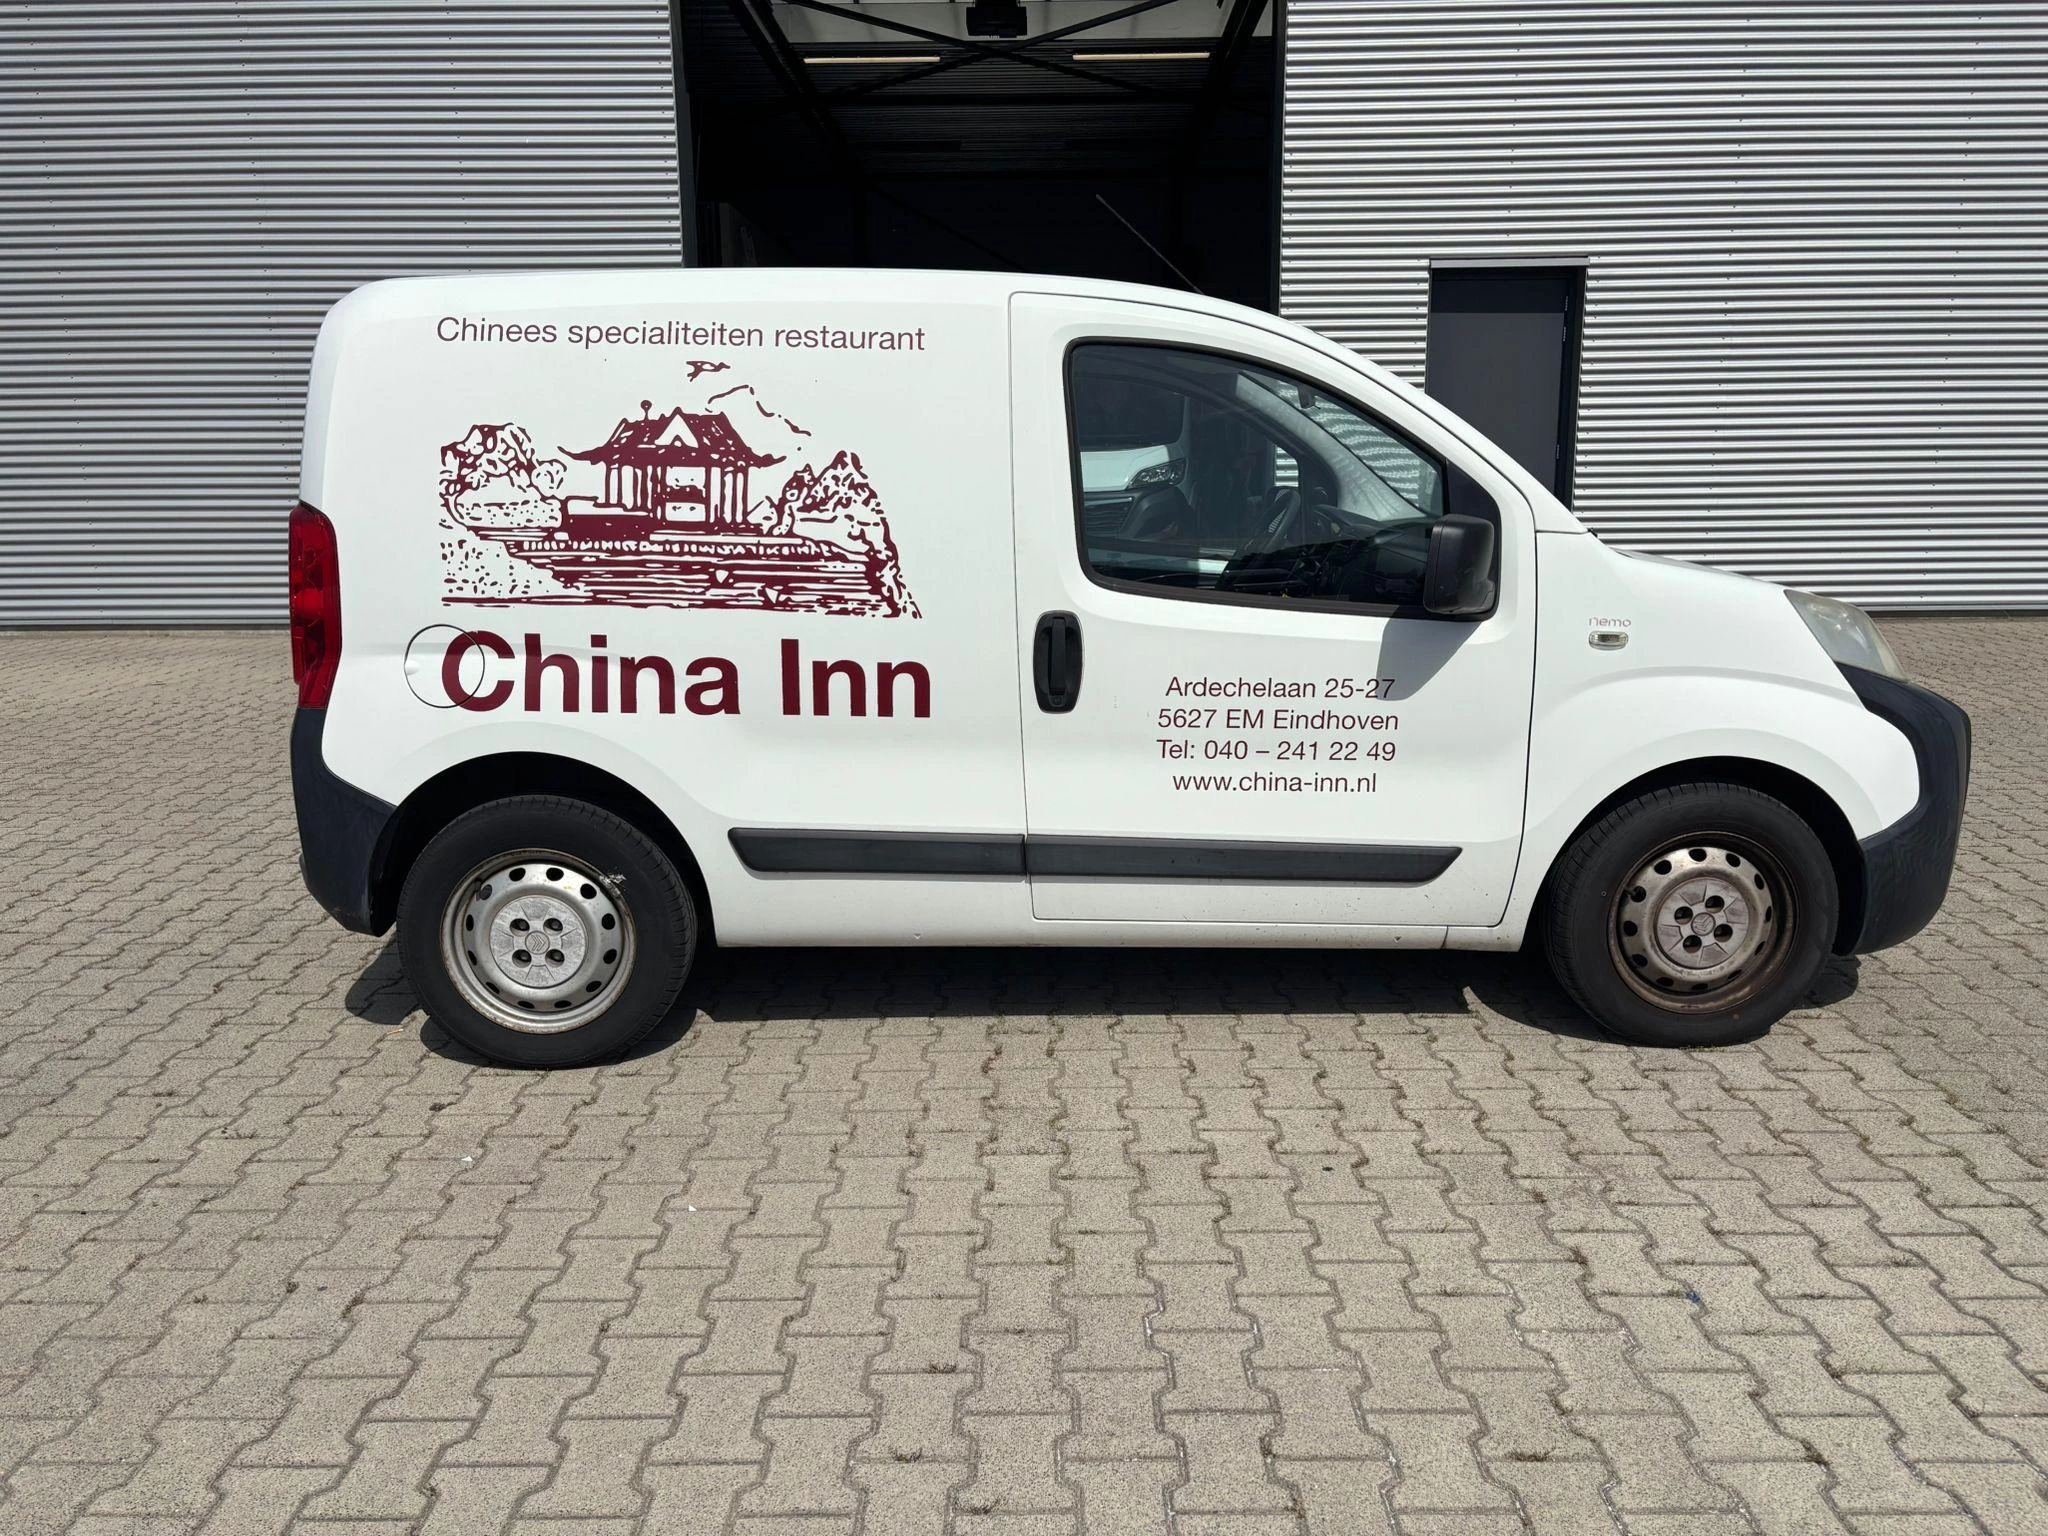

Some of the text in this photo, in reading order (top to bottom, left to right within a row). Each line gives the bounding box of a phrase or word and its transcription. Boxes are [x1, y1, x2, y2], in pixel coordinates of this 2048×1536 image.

[436, 316, 926, 351] Chinees specialiteiten restaurant
[1588, 616, 1632, 628] nemo
[442, 631, 931, 718] China Inn
[1164, 675, 1397, 700] Ardechelaan 25-27
[1157, 708, 1399, 731] 5627 EM Eindhoven
[1155, 739, 1195, 760] Tel:
[1203, 739, 1249, 760] 040
[1276, 740, 1318, 761] 241
[1328, 741, 1359, 761] 22
[1365, 741, 1396, 762] 49
[1172, 771, 1377, 793] www.china-inn.nl
